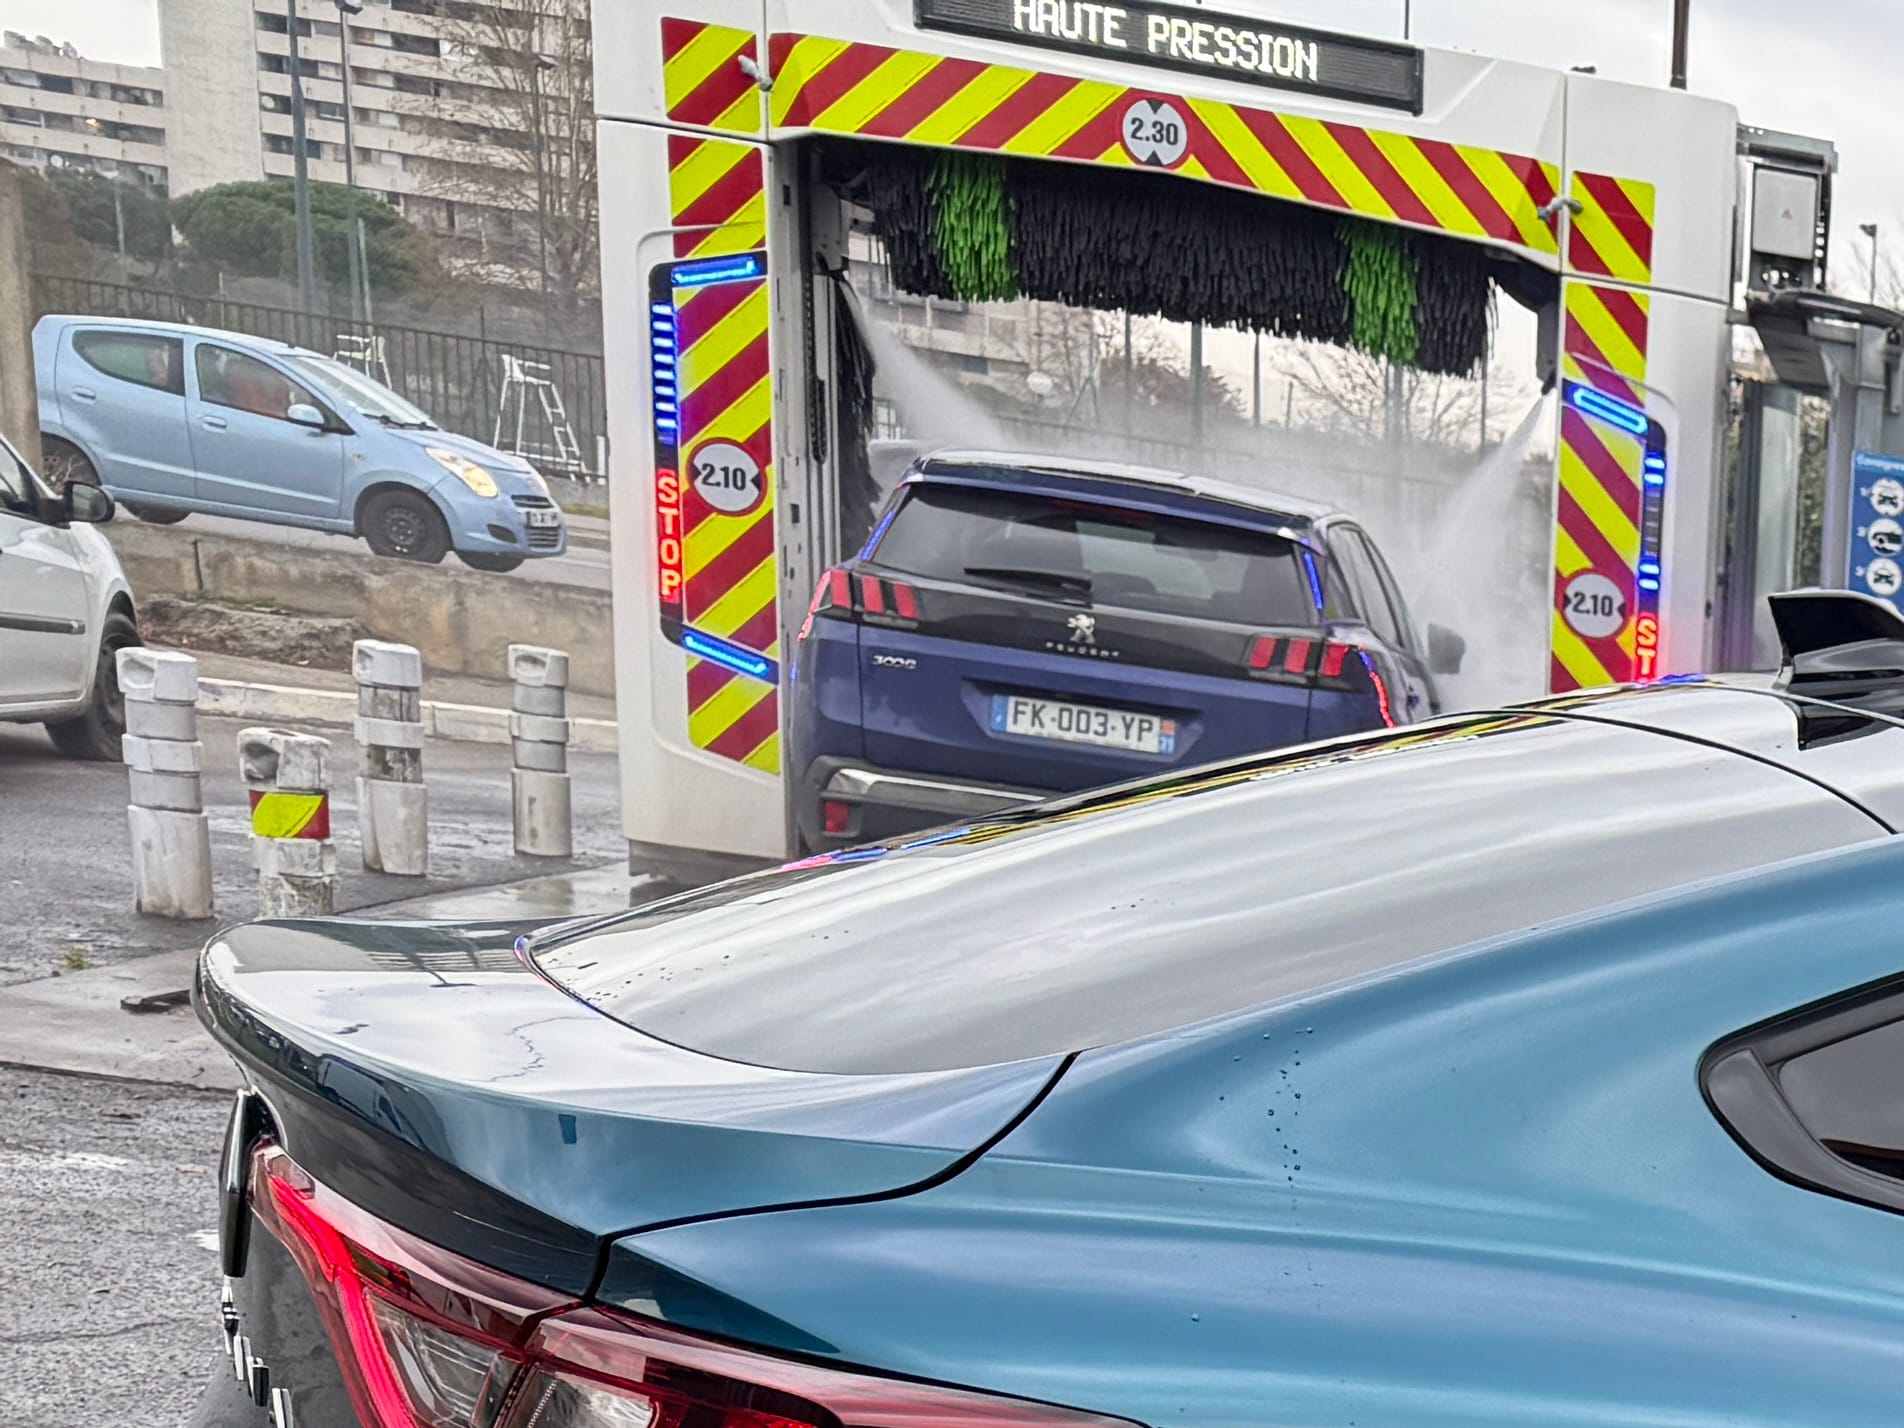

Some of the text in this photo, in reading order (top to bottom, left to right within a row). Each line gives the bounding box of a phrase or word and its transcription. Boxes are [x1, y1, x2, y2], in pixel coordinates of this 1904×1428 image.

[1013, 0, 1319, 82] HAUTE PRESSION
[1130, 116, 1179, 146] 2.30
[701, 462, 747, 491] 2.10
[657, 475, 681, 596] STOP
[1571, 591, 1614, 617] 2.10
[1636, 617, 1658, 676] ST
[1012, 701, 1155, 744] FK-003-YP
